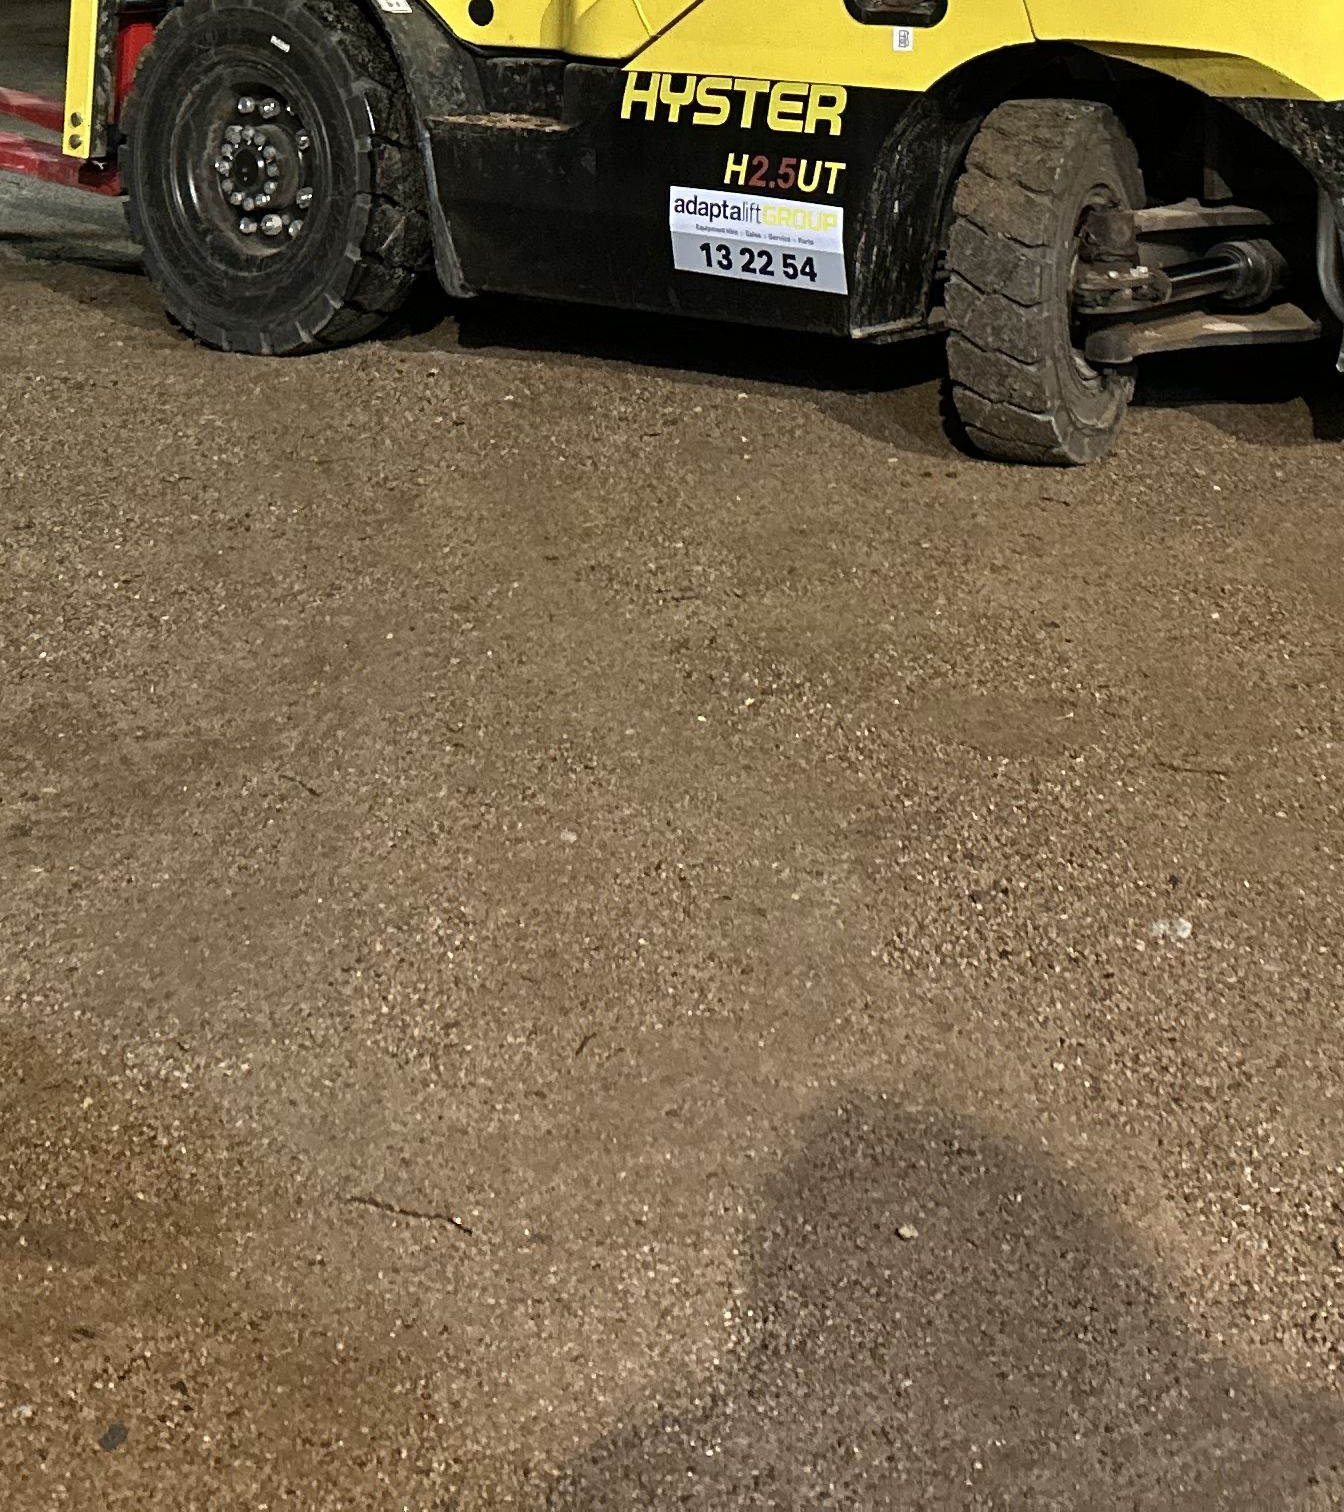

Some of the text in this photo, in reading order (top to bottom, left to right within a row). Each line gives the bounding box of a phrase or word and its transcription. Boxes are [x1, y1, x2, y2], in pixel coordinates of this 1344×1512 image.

[620, 72, 848, 136] HYSTER
[724, 152, 846, 194] H2.5UT
[699, 242, 817, 282] 13 22 54
